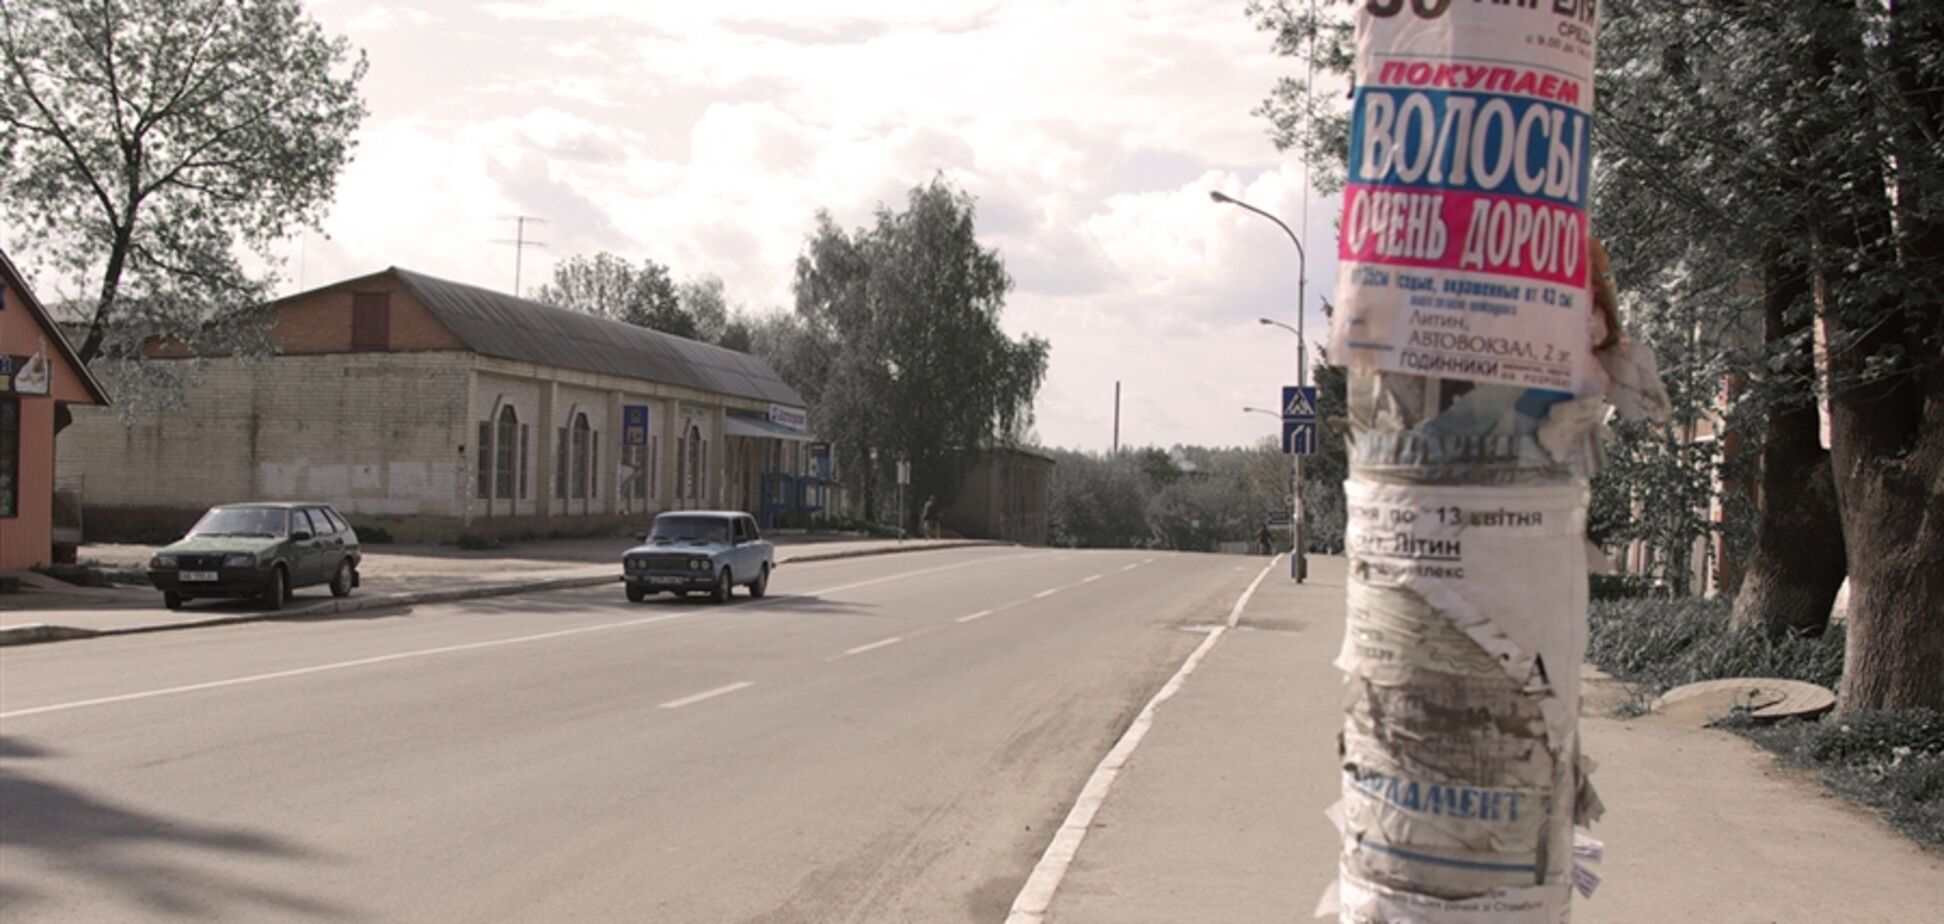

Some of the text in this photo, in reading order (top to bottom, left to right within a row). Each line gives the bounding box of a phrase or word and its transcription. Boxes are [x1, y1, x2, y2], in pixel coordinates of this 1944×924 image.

[1378, 60, 1580, 106] ПОКУПАЕМ
[1359, 91, 1584, 201] ВОЛОСЫ
[1349, 188, 1580, 279] ОЧЕНЬ ДОРОГО
[1409, 309, 1470, 332] Литин,
[1408, 329, 1538, 361] АВТОВОКЗАЛ,
[1400, 350, 1499, 378] ГОДИННИКИ
[1468, 505, 1543, 528] квітня
[1394, 531, 1461, 556] Літин
